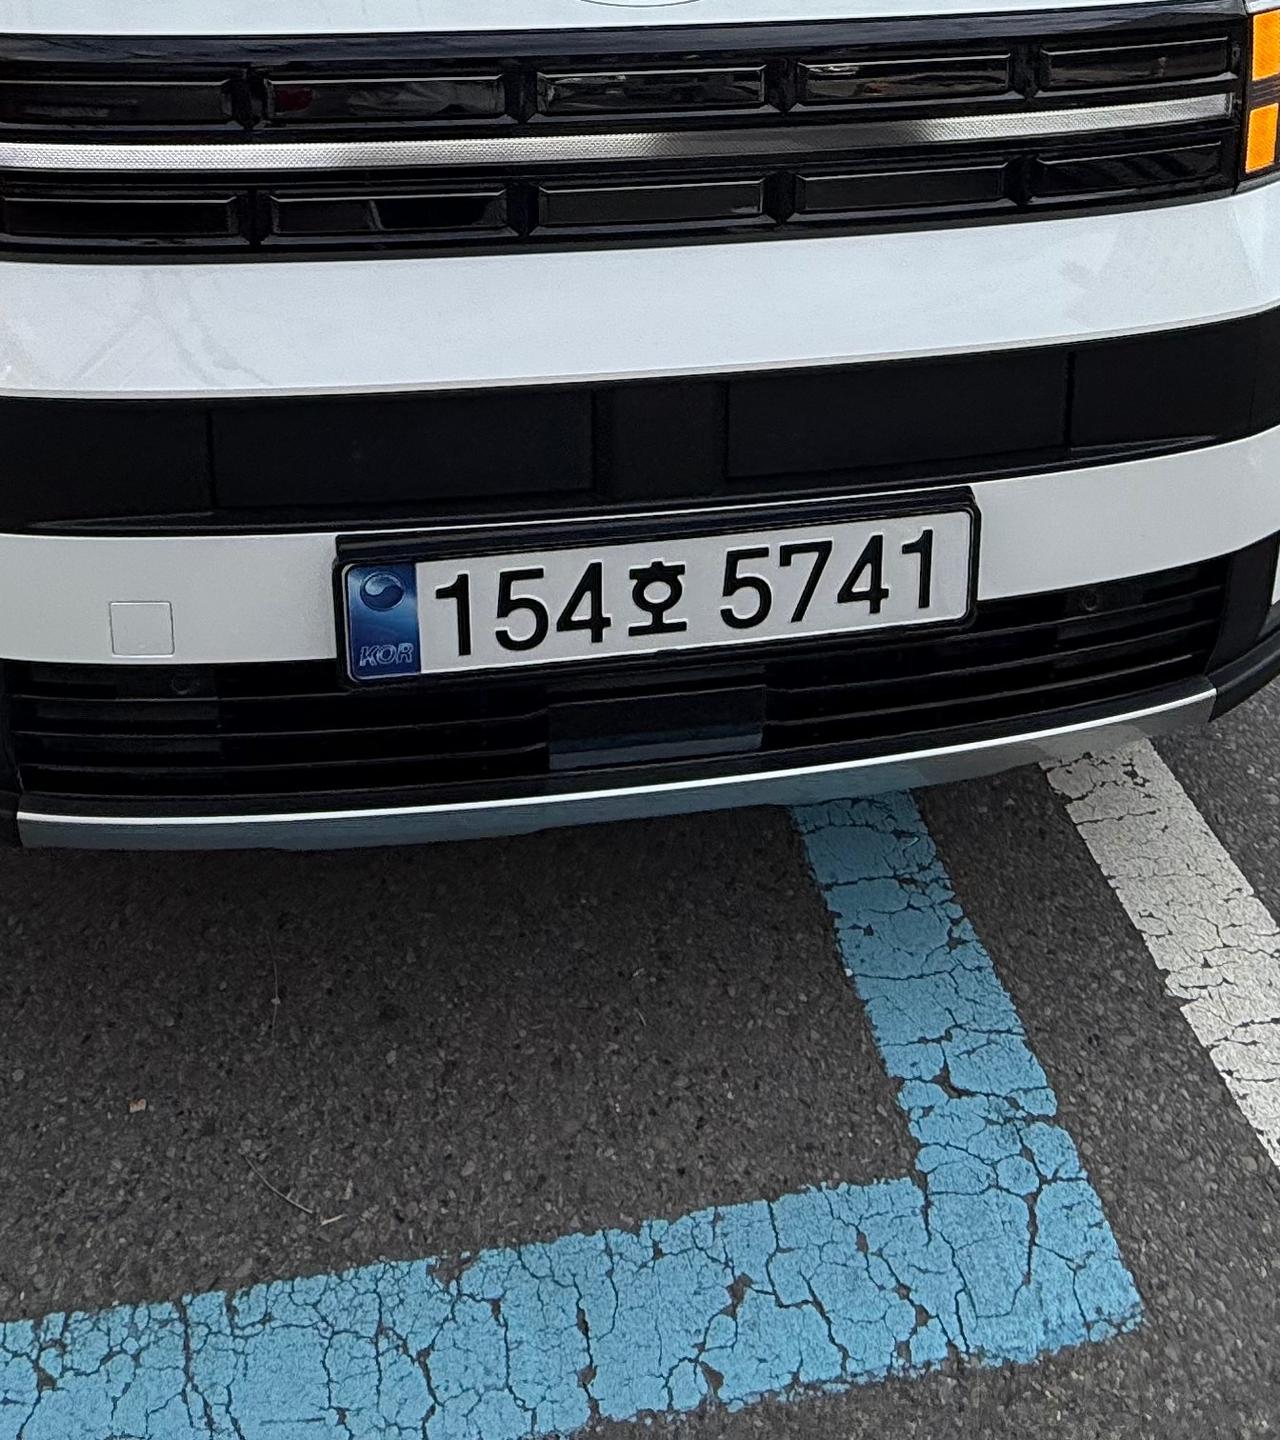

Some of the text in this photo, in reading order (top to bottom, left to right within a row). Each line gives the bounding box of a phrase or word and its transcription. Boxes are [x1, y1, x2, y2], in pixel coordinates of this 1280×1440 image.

[433, 528, 936, 656] 154호 5741
[359, 641, 415, 668] KOR
